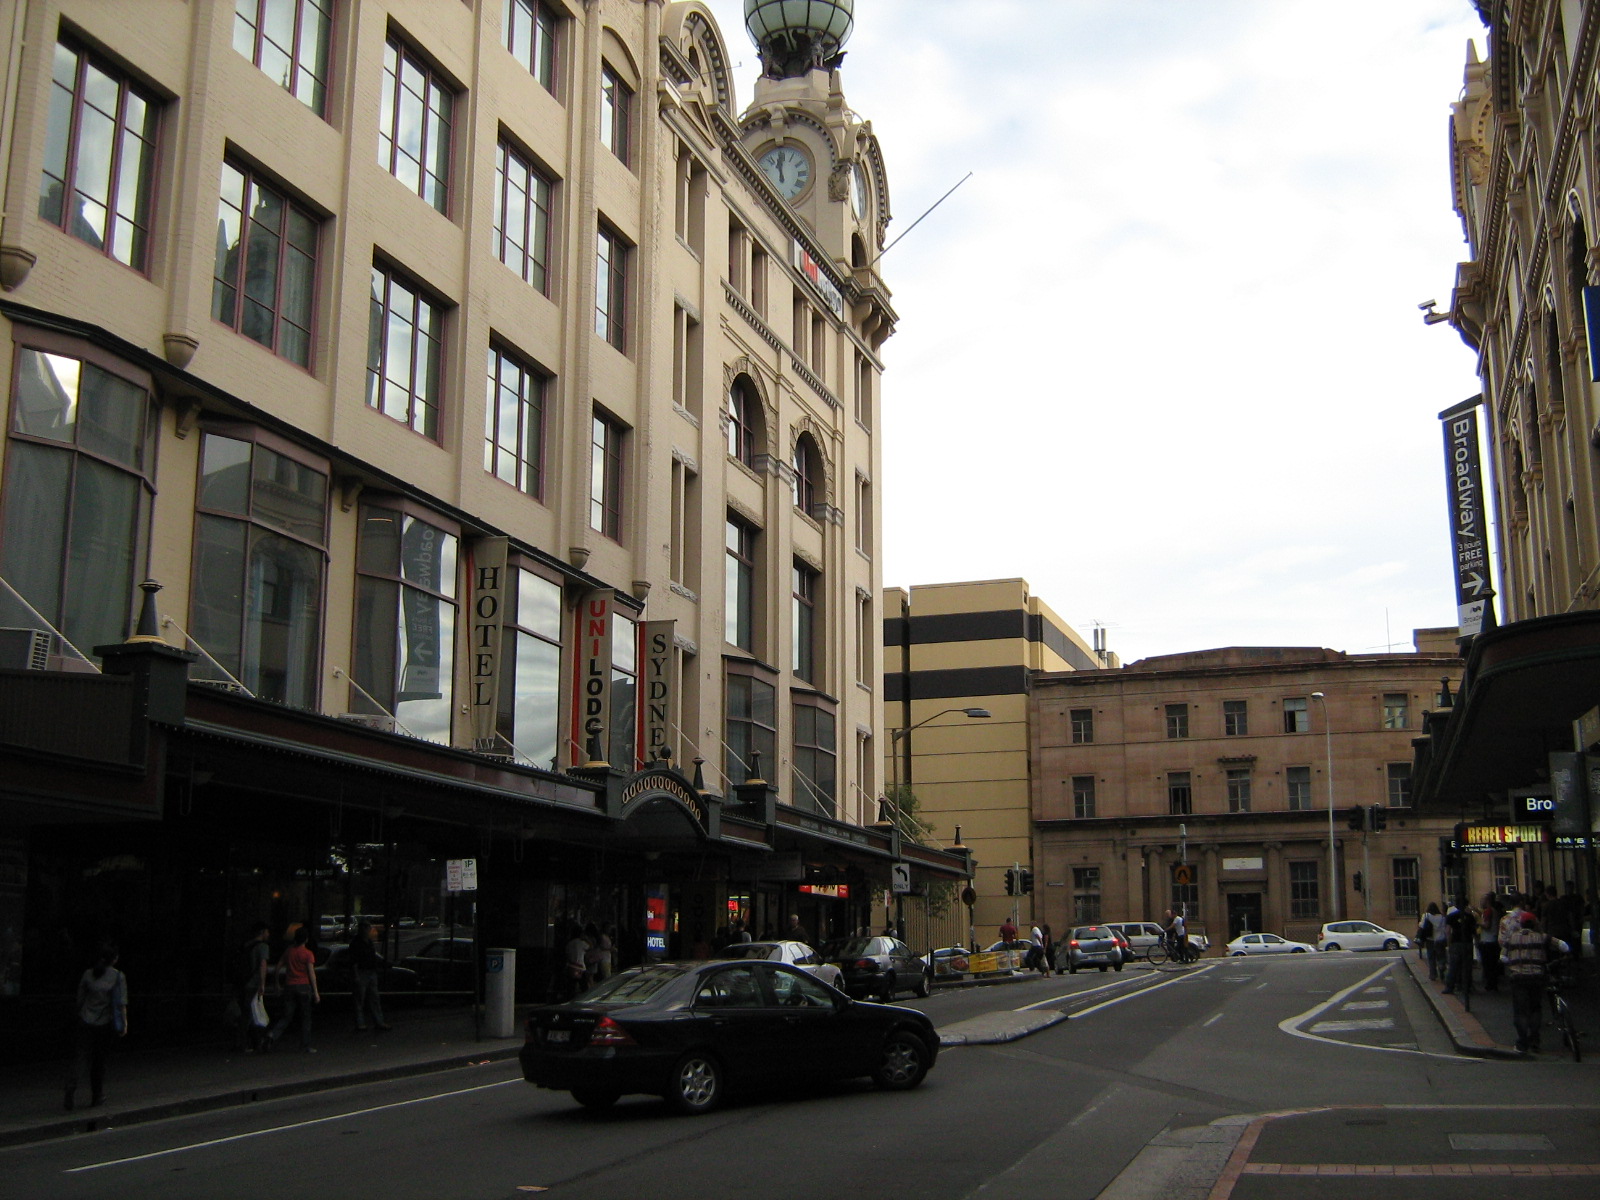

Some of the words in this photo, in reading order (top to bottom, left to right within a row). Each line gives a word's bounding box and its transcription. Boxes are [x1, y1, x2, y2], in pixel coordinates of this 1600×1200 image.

[1453, 418, 1475, 538] Broadway
[1464, 539, 1482, 550] hours
[1459, 548, 1483, 563] FREE
[1460, 559, 1484, 572] parking
[474, 566, 499, 706] HOTEL
[1526, 797, 1555, 811] Bro
[1467, 826, 1501, 844] REBEL
[1504, 825, 1543, 843] SPORT
[647, 936, 666, 949] HOTEL
